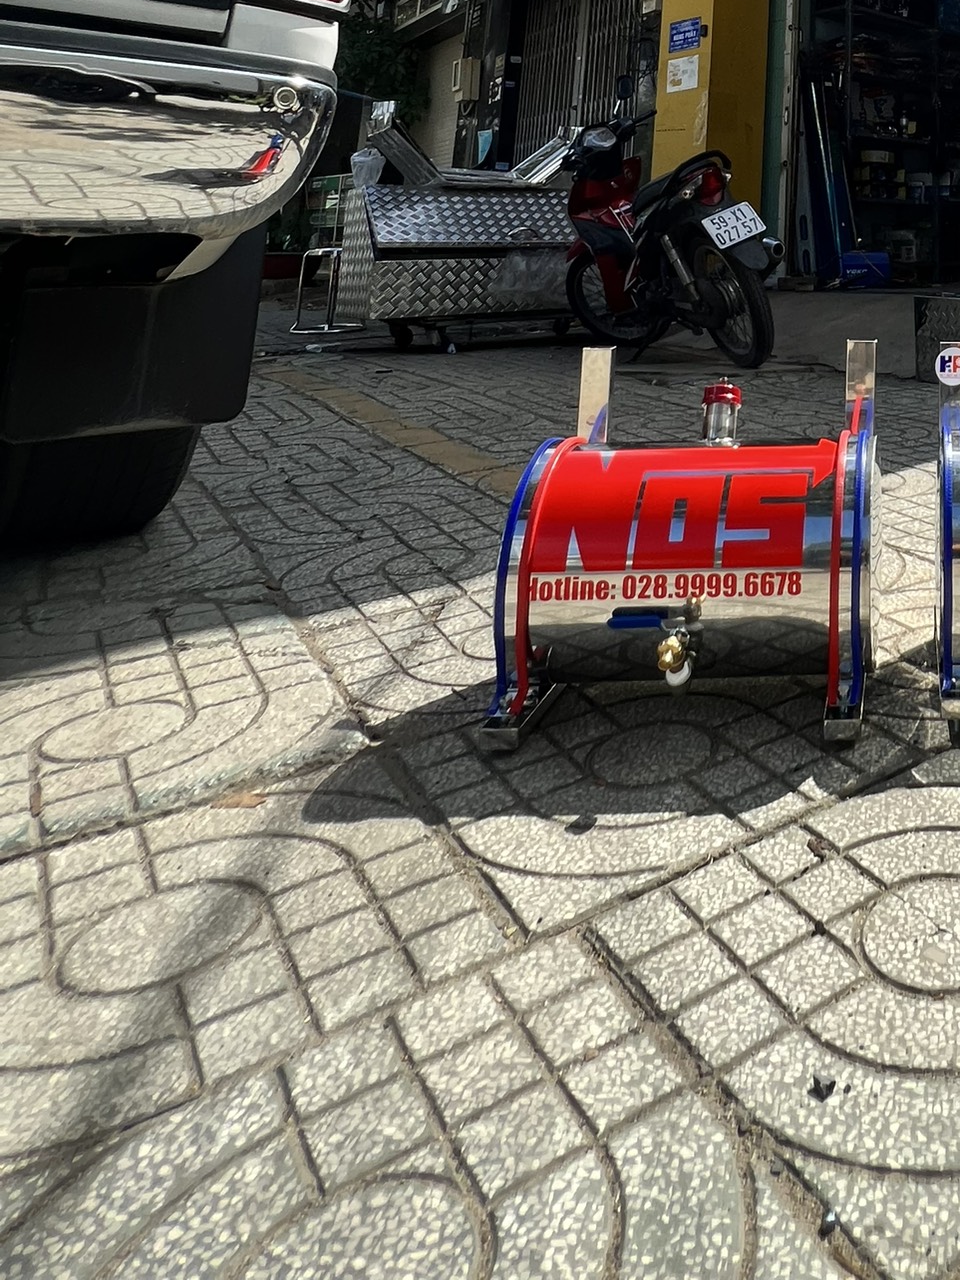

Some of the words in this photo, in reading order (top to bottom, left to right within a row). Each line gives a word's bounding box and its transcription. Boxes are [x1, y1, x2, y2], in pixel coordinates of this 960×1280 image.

[710, 207, 748, 230] 59-X1
[715, 217, 759, 245] 027.57
[528, 438, 837, 572] NOS
[621, 570, 802, 600] 028.9999.6678
